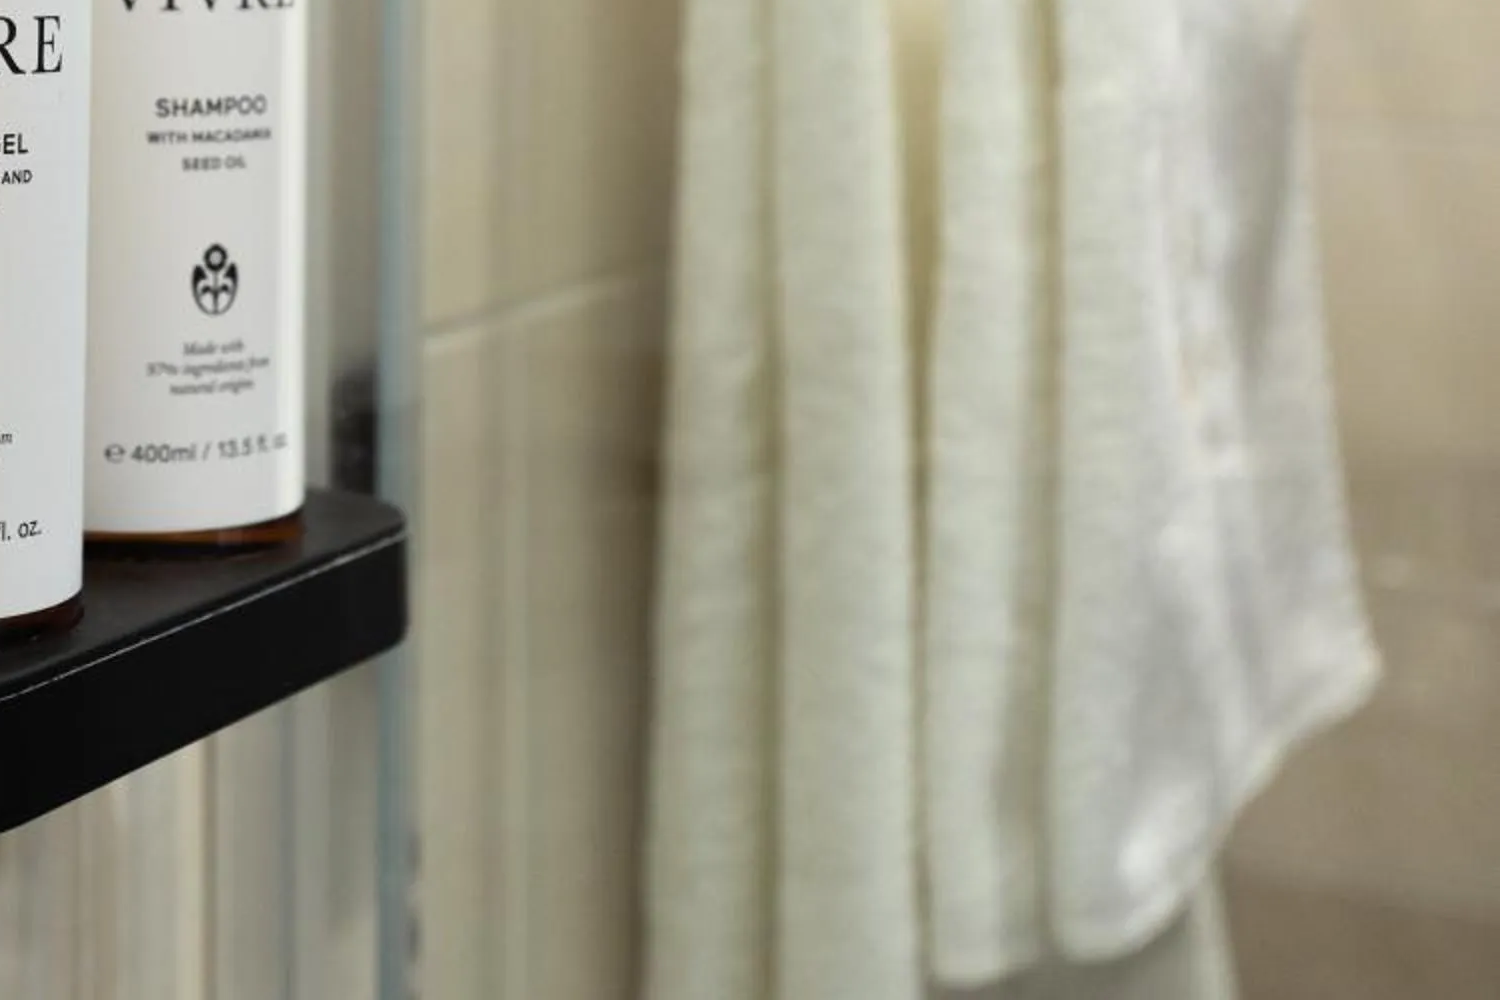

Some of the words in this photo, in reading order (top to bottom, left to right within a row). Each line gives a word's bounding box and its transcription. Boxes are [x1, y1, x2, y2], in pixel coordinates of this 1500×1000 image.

[154, 94, 268, 119] SHAMPOO
[146, 130, 188, 145] WITH
[1, 169, 33, 185] AND
[131, 444, 196, 463] 400ml
[202, 442, 212, 461] /
[17, 520, 43, 539] oz.
